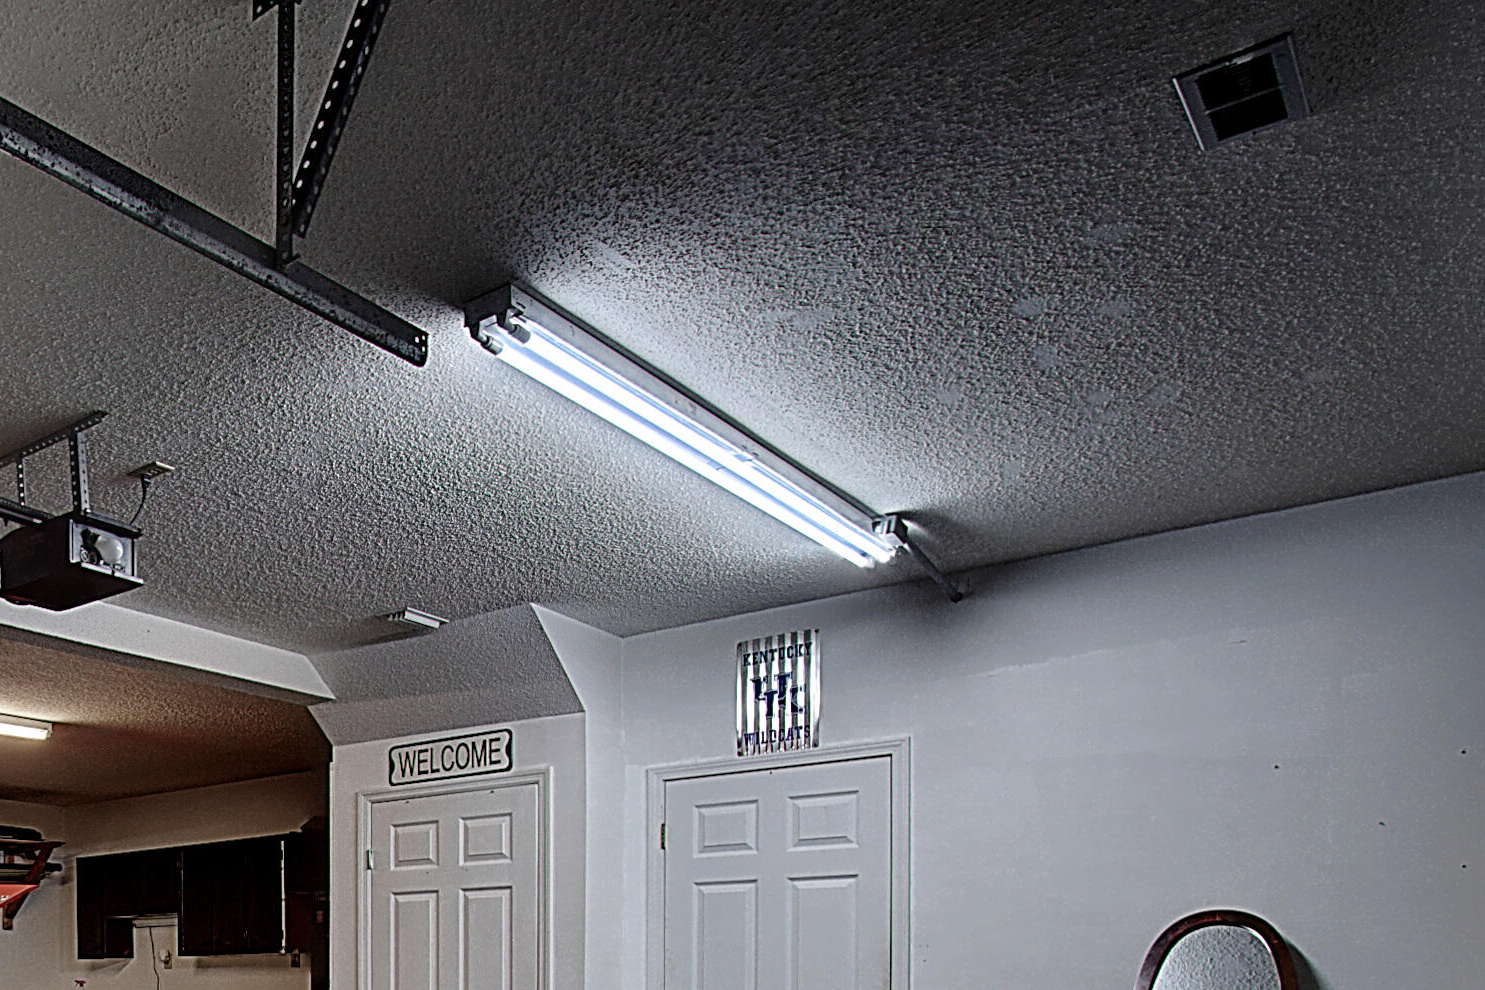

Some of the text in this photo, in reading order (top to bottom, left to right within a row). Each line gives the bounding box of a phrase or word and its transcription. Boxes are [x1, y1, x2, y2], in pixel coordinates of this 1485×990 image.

[743, 641, 812, 667] KENTUCKY
[750, 672, 806, 719] UK
[744, 725, 810, 746] WILDCATS
[398, 737, 501, 778] WELCOME
